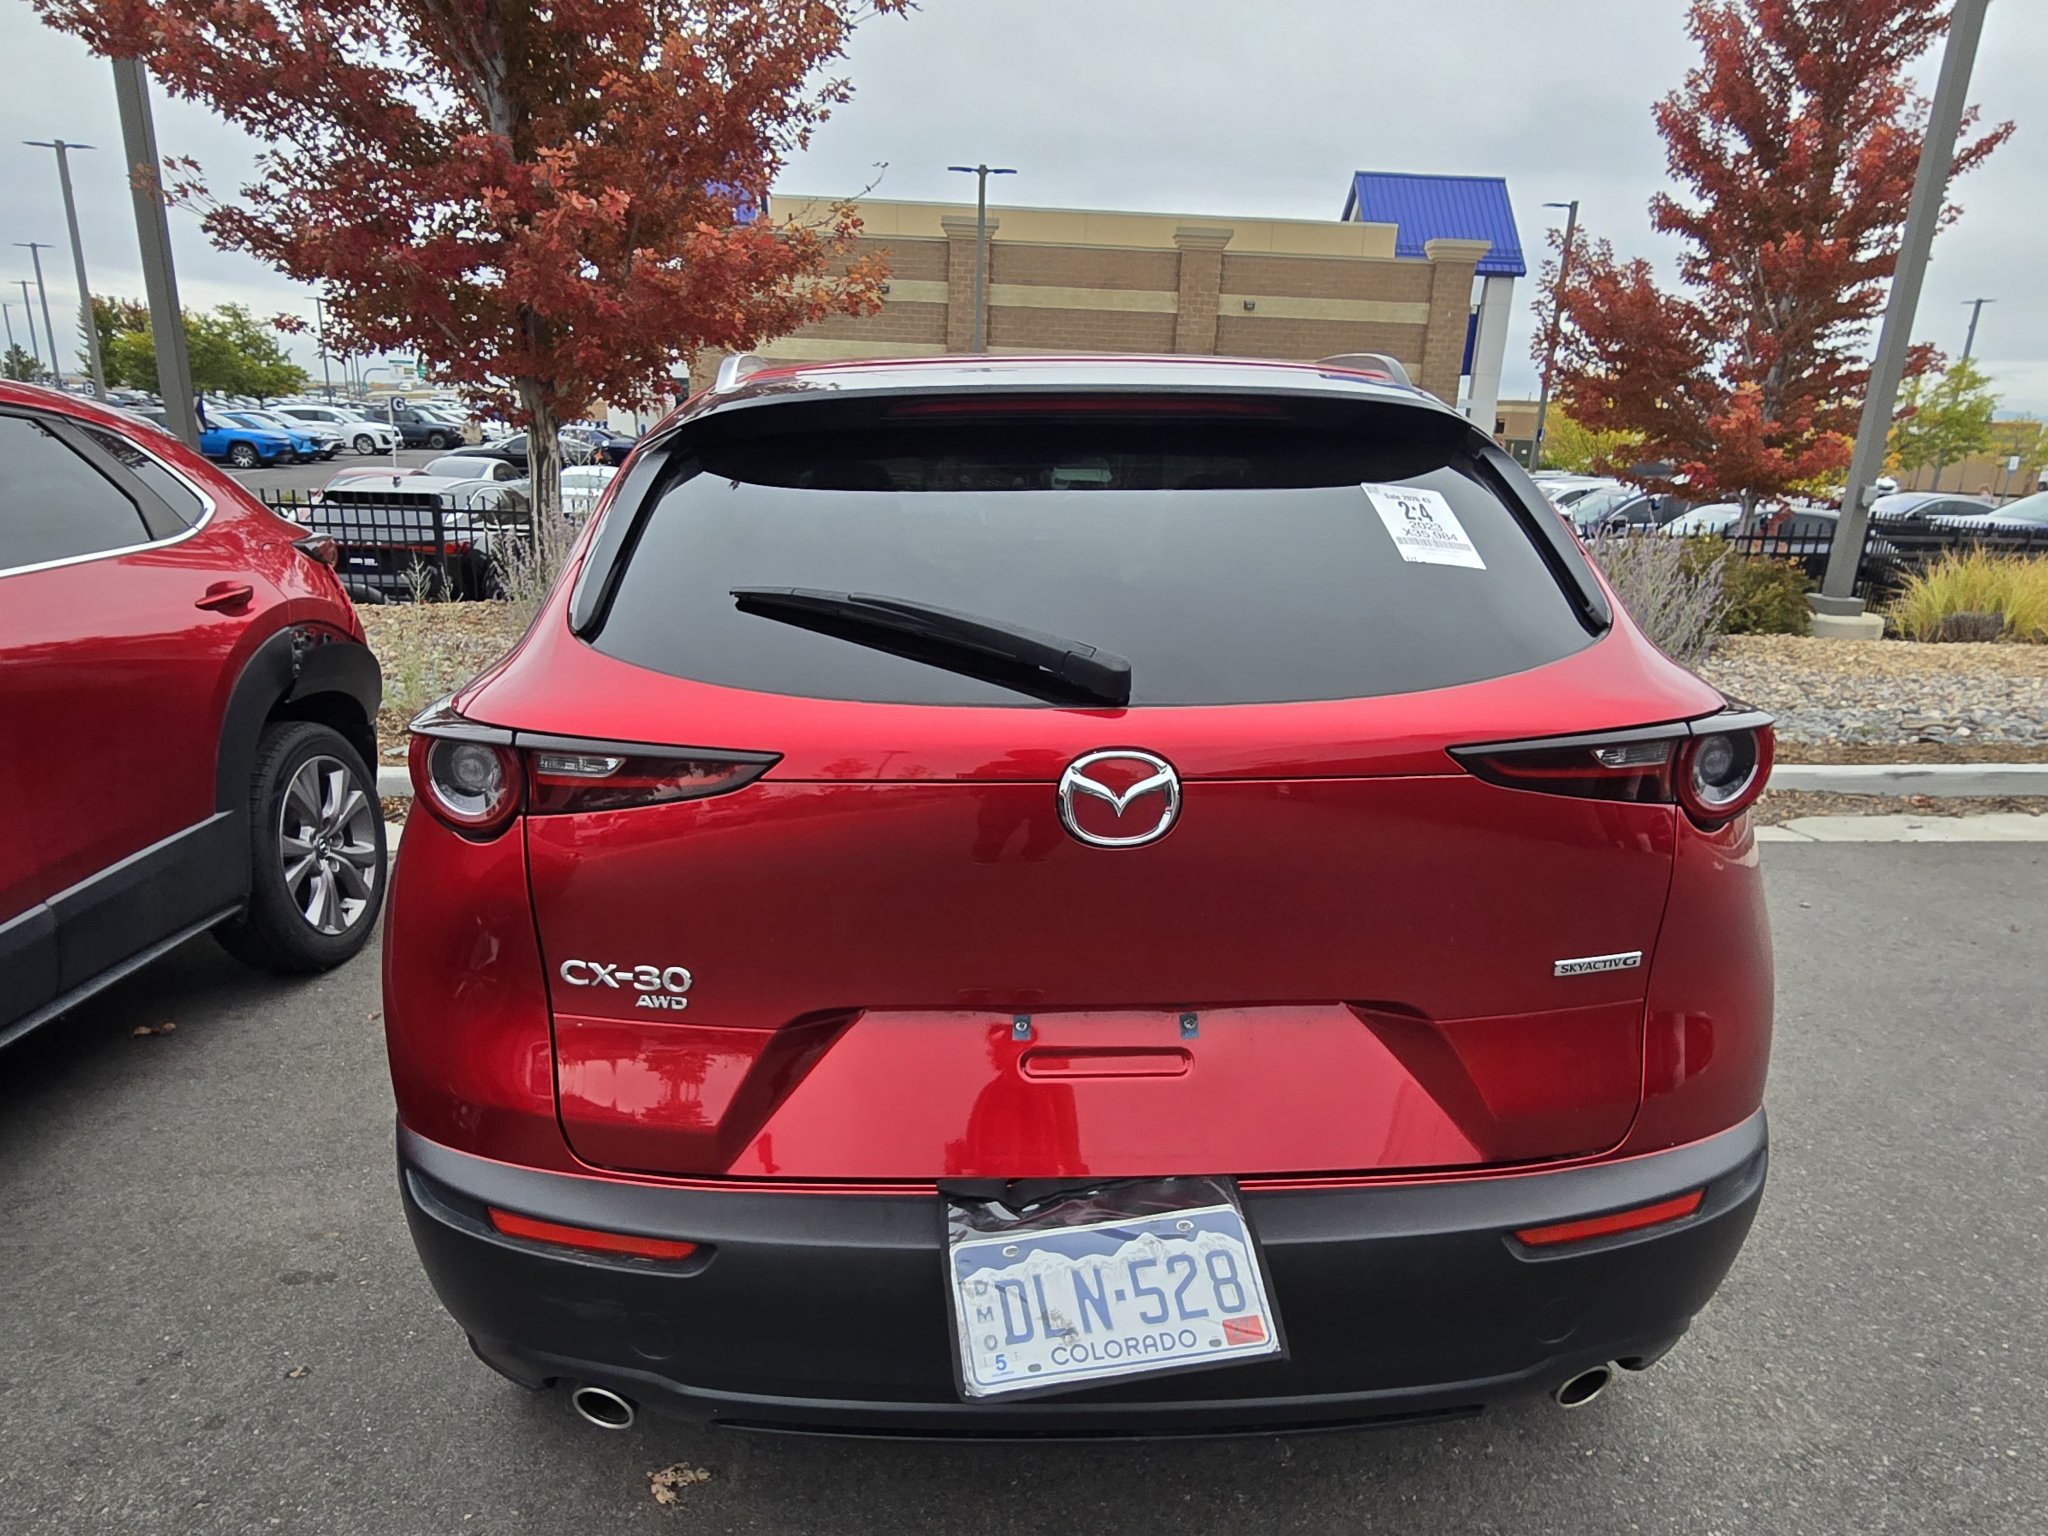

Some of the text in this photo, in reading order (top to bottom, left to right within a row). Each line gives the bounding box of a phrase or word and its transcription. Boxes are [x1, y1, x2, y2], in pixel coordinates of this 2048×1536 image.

[85, 382, 95, 395] B
[392, 397, 405, 412] G
[1397, 500, 1434, 522] 2:4
[1408, 520, 1443, 532] 2023
[559, 958, 693, 993] CX-30
[635, 994, 688, 1010] AWD
[1050, 1328, 1198, 1367] COLORADO
[995, 1353, 1008, 1371] 5
